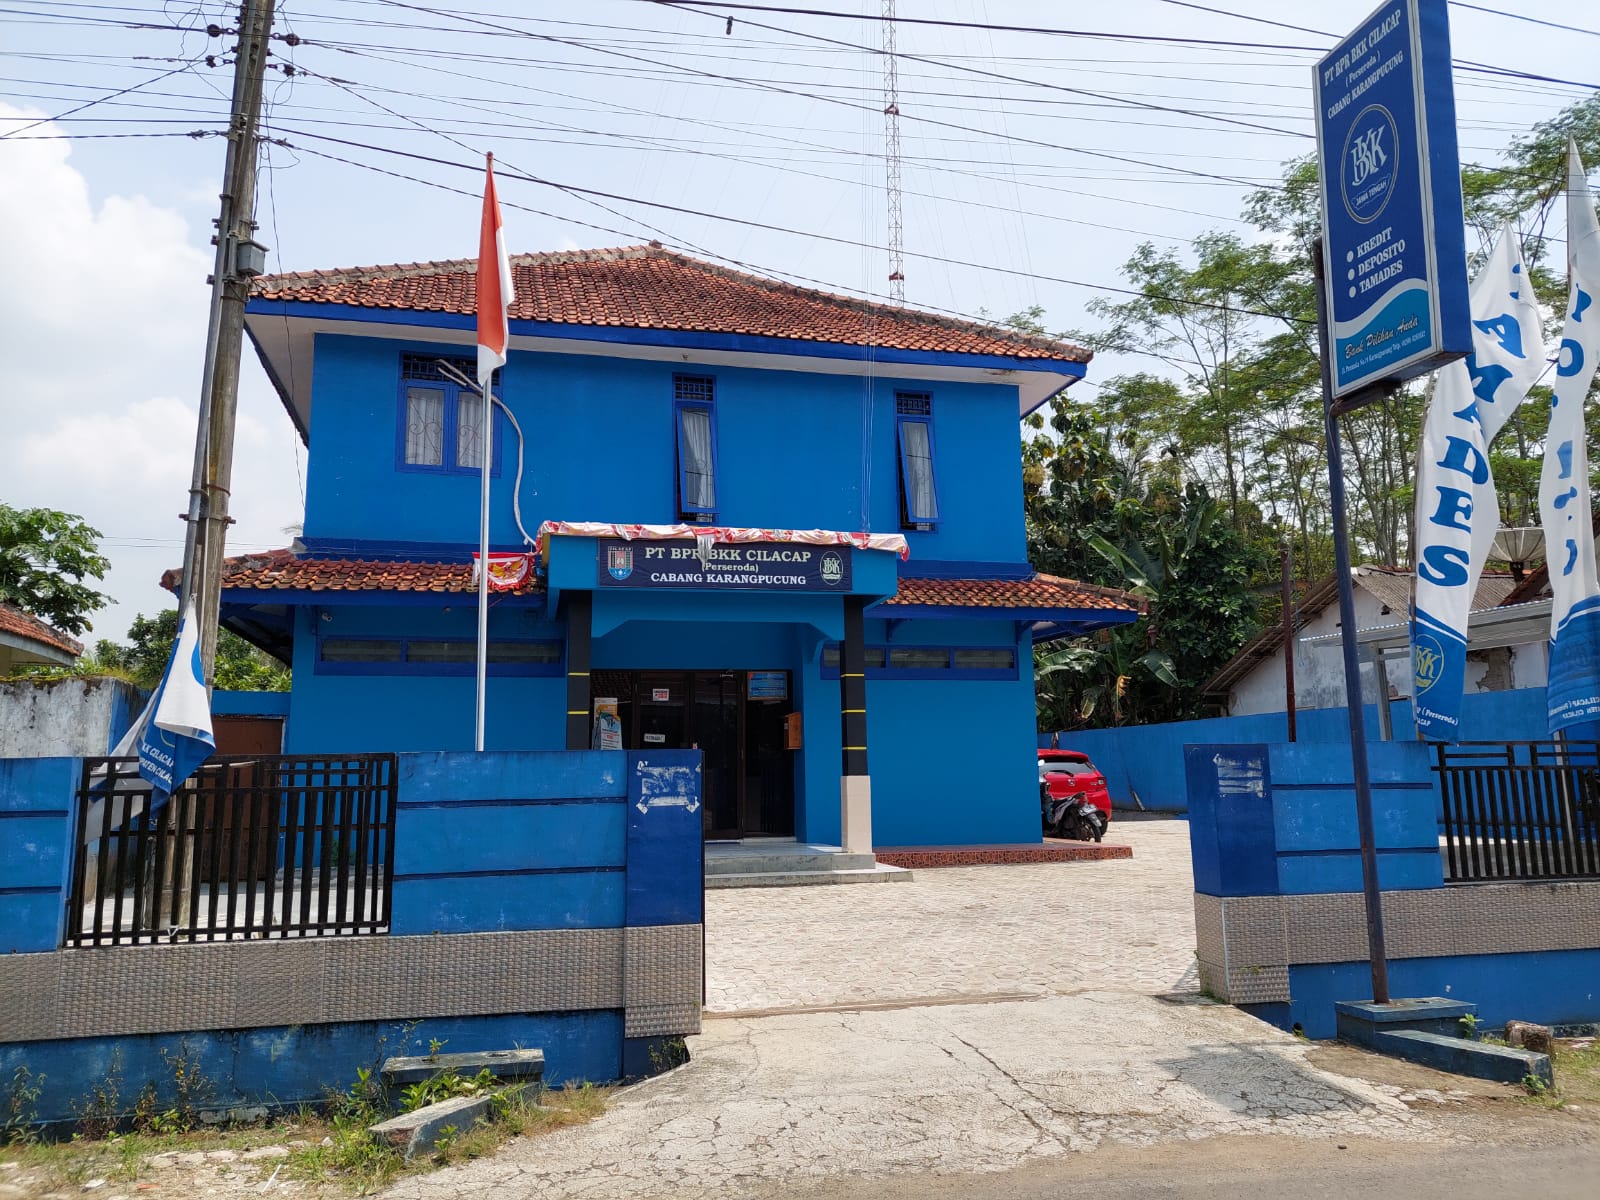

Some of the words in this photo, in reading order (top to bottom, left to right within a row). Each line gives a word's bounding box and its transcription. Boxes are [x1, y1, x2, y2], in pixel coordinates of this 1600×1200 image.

[1324, 66, 1334, 87] PT
[1335, 53, 1350, 77] BPR
[1351, 37, 1368, 63] BKK
[1368, 9, 1400, 48] CILACAP
[1328, 93, 1351, 119] CABANG
[1351, 50, 1404, 101] KARANGPUCUNG
[1357, 226, 1392, 258] KREDIT
[1358, 239, 1406, 276] DEPOSITO
[1359, 259, 1403, 293] TAMADES
[1345, 340, 1364, 359] Bank
[645, 547, 665, 559] PT
[670, 548, 701, 559] BPR
[708, 549, 741, 561] BKK
[746, 550, 811, 562] CILACAP
[650, 573, 703, 583] CABANG
[706, 574, 807, 585] KARANGPUCUNG
